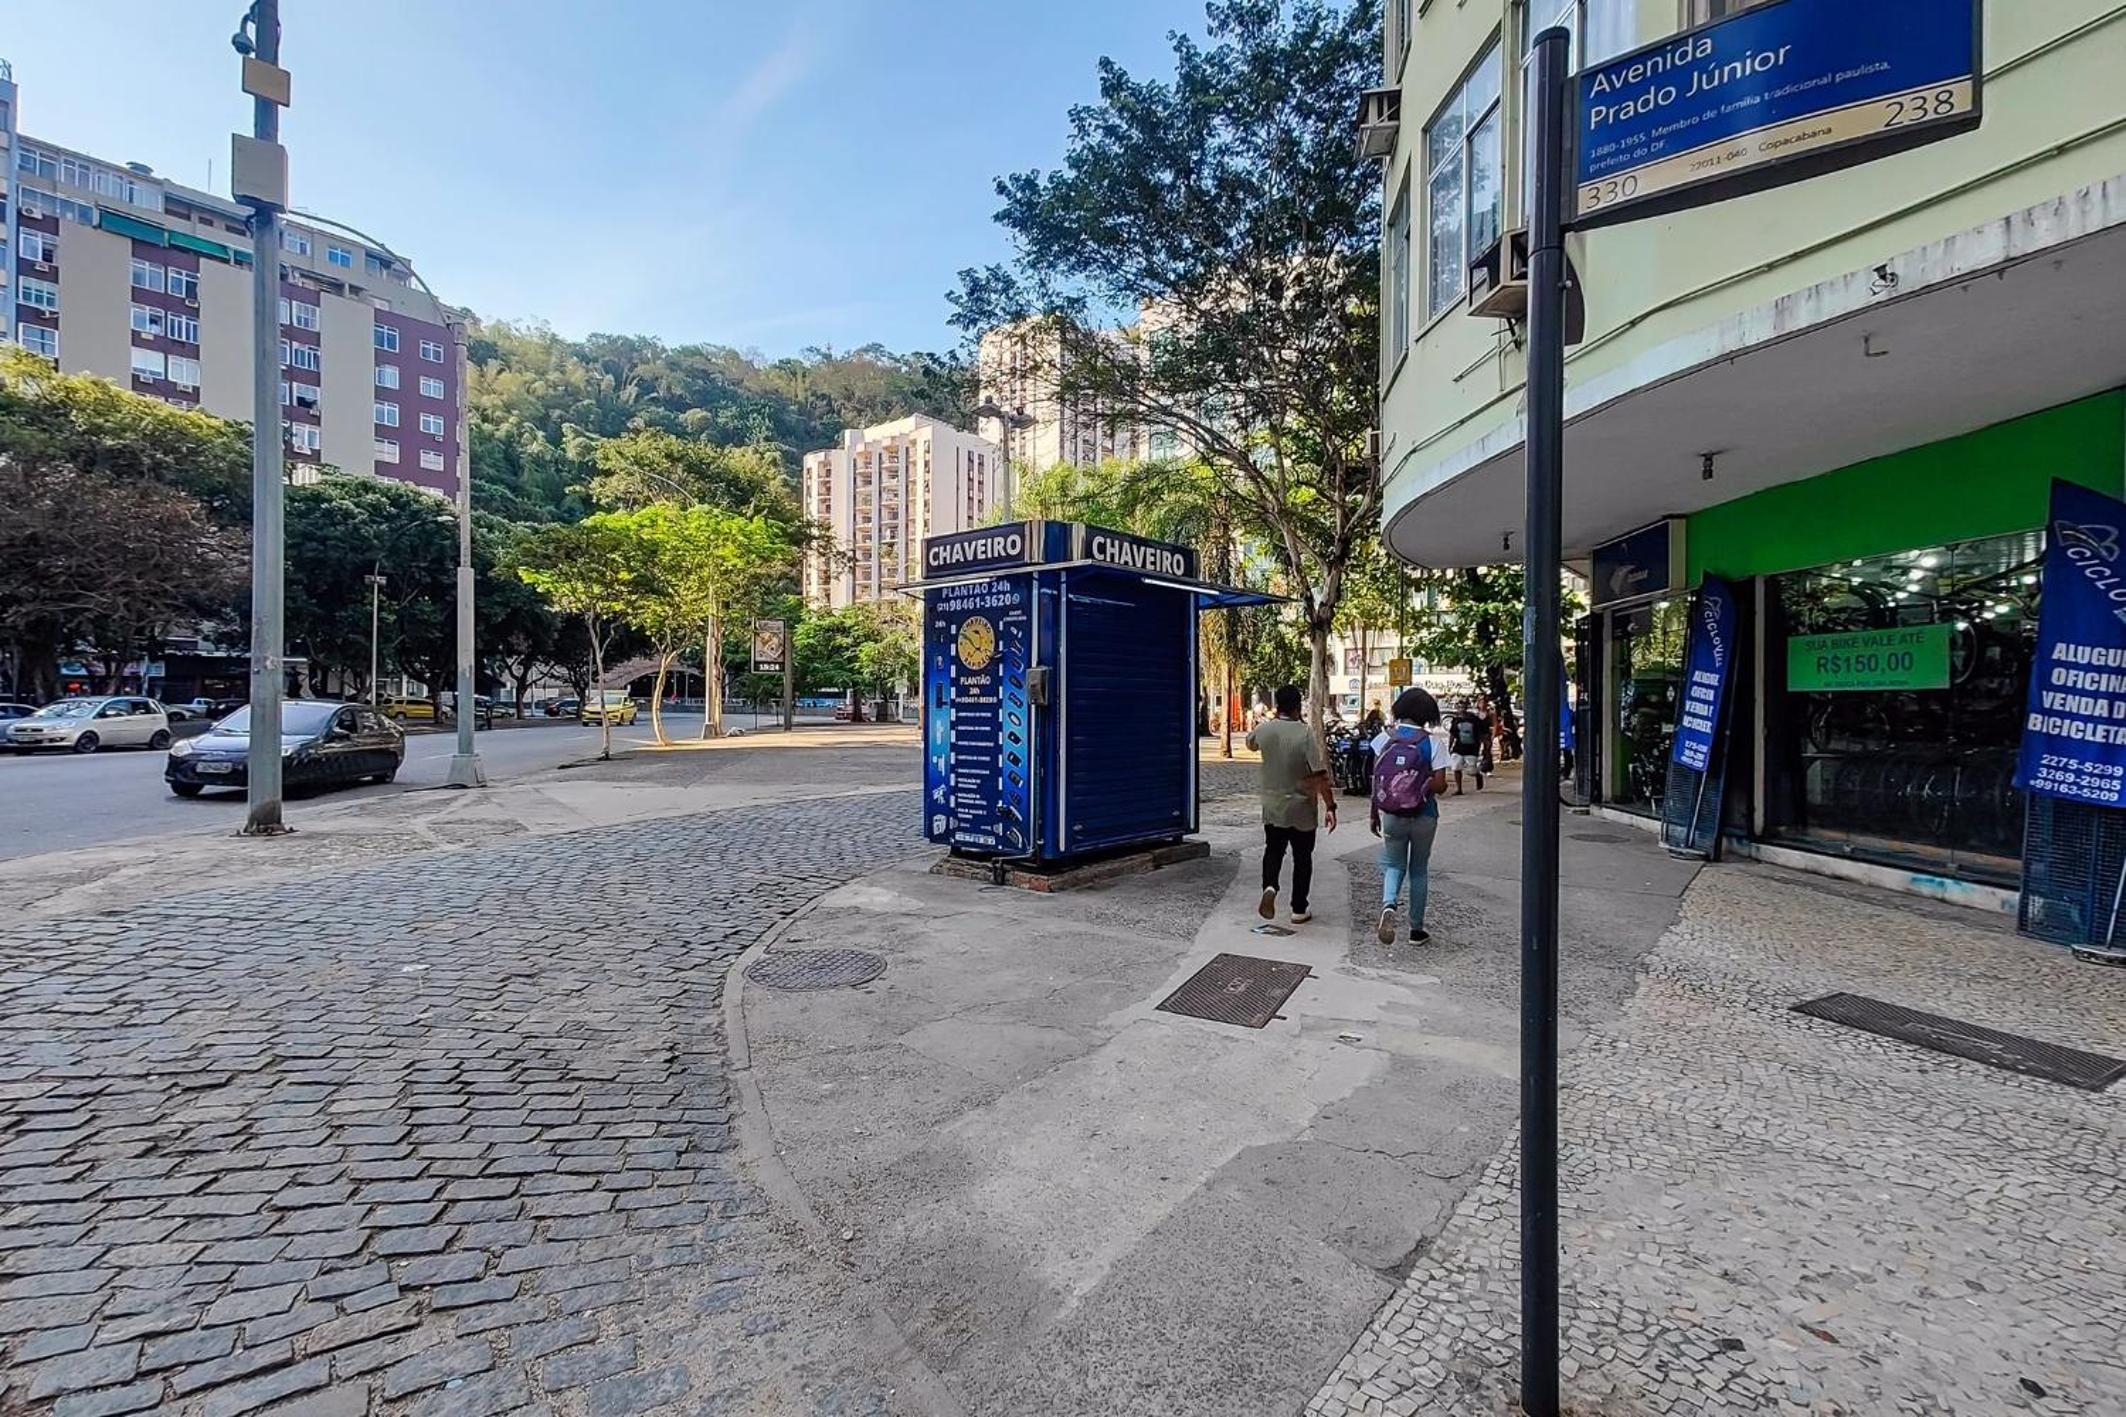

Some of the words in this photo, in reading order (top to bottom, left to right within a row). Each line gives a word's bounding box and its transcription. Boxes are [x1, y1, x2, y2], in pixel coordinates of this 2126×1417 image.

[1589, 37, 1712, 99] Avenida
[1590, 85, 1677, 131] Prado
[1685, 44, 1792, 98] Júnior
[1651, 116, 1700, 138] Membro
[1702, 109, 1718, 121] de
[1763, 73, 1832, 101] tradicional
[1586, 175, 1638, 210] 330
[1758, 126, 1832, 152] Copacabana
[1884, 89, 1955, 128] 238
[1589, 154, 1631, 173] prefeito
[1633, 147, 1648, 158] do
[928, 533, 1022, 567] CHAVEIRO
[1092, 535, 1185, 577] CHAVEIRO
[991, 580, 1011, 593] 24h
[1831, 637, 1860, 648] BIKE
[1862, 634, 1895, 647] VALE
[1816, 651, 1914, 676] R$150,00
[2042, 690, 2109, 717] VENDA
[2040, 754, 2124, 777] 2275-5299
[2035, 779, 2119, 801] 99163-5209
[2037, 767, 2122, 791] 3269-2965
